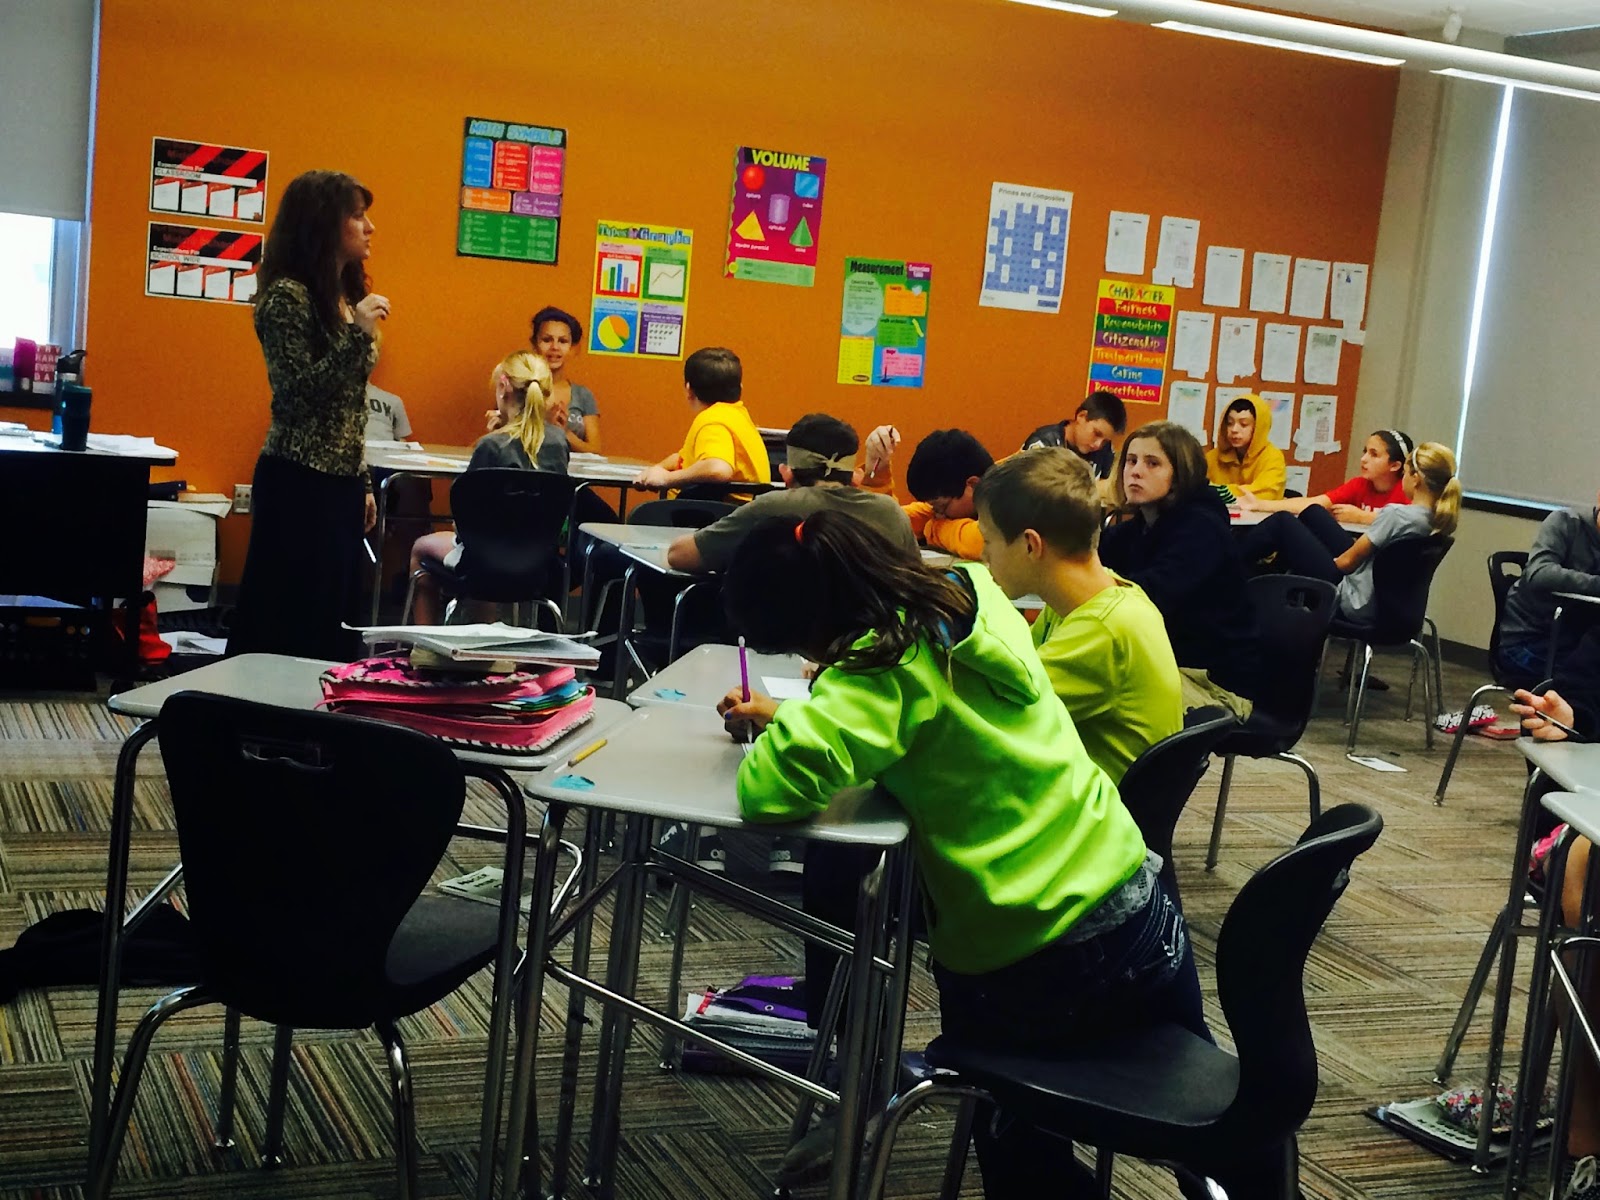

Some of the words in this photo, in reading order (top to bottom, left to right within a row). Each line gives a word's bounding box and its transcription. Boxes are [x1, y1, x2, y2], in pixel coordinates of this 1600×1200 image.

[470, 120, 505, 138] MATH
[507, 124, 563, 144] SYMBOLS
[752, 150, 810, 171] VOLUME
[156, 168, 202, 178] CLASSROOM
[599, 224, 628, 238] Types
[640, 228, 691, 245] Graphs
[152, 253, 180, 262] SCHOOL
[850, 260, 904, 276] Measurement
[1108, 284, 1164, 302] CHARACTER
[1114, 300, 1158, 316] Fairness
[1104, 315, 1162, 334] Responsibility
[1102, 332, 1160, 350] Citizenship
[1112, 366, 1143, 382] Caring
[1094, 382, 1156, 397] Respectfulness
